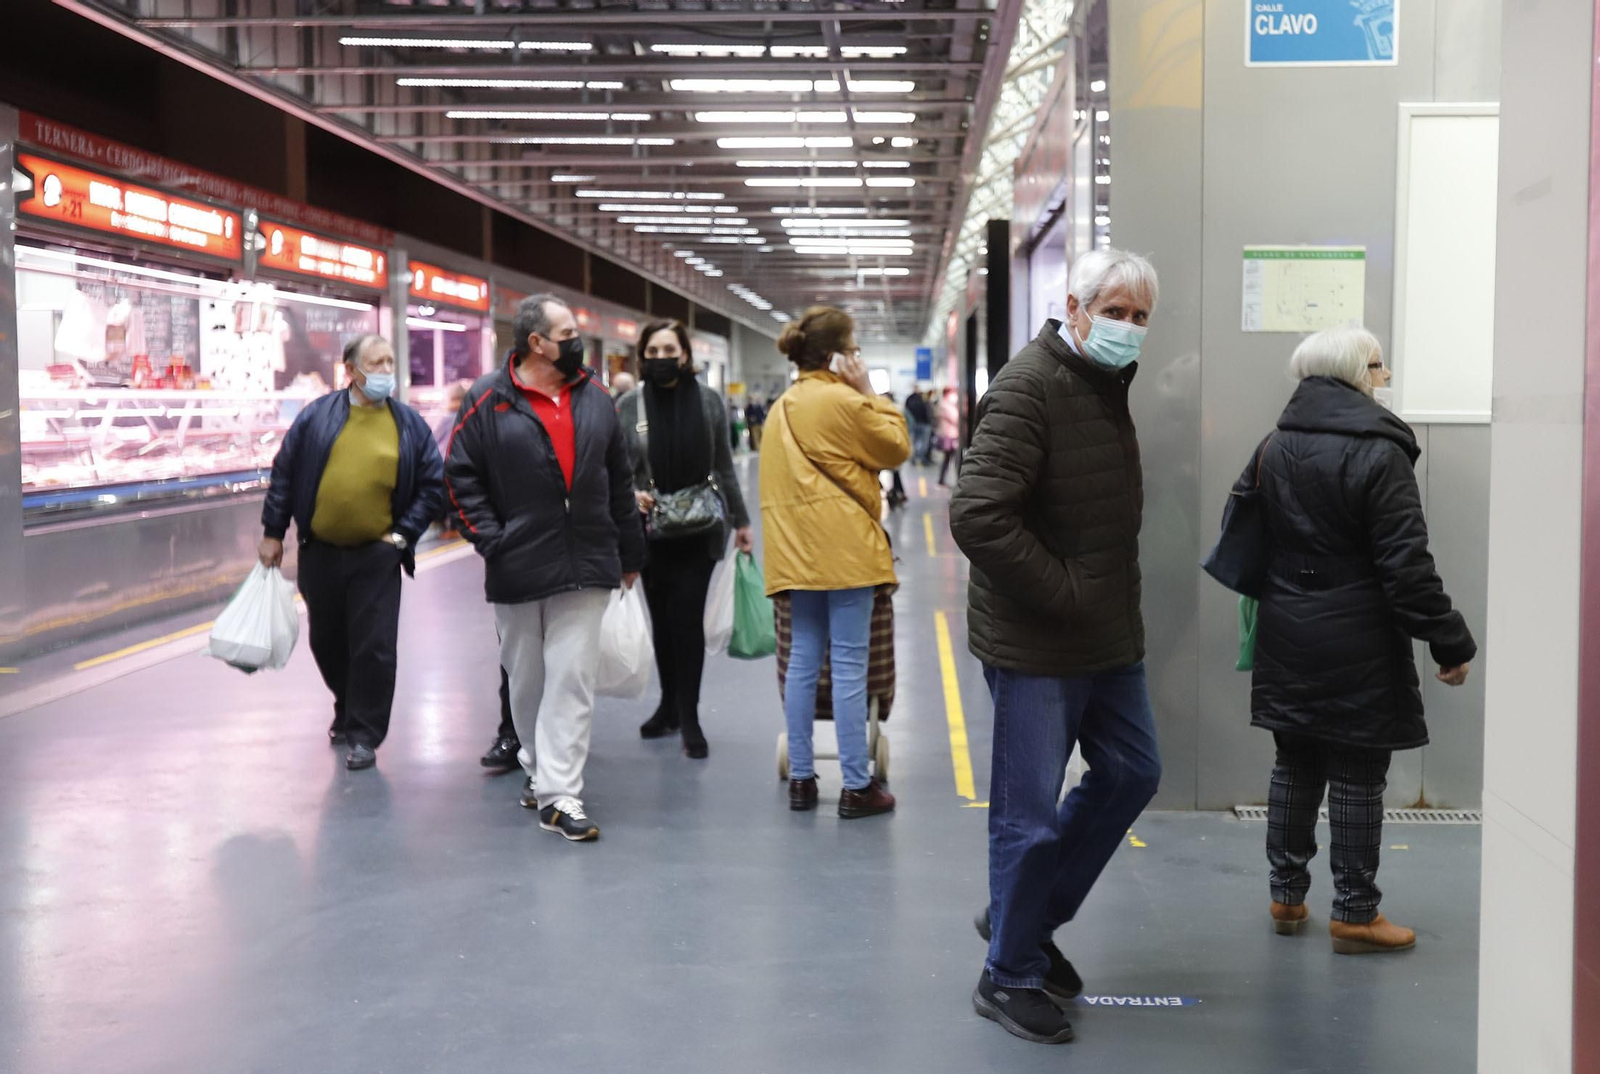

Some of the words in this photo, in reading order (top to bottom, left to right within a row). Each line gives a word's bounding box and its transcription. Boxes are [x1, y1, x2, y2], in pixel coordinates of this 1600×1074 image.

[1255, 3, 1284, 12] CALLE
[1255, 13, 1318, 35] CLAVO
[35, 119, 94, 158] TERNERA
[106, 143, 145, 170] CERDO
[197, 173, 238, 202] CORDERO
[1084, 996, 1183, 1006] ENTRADA
